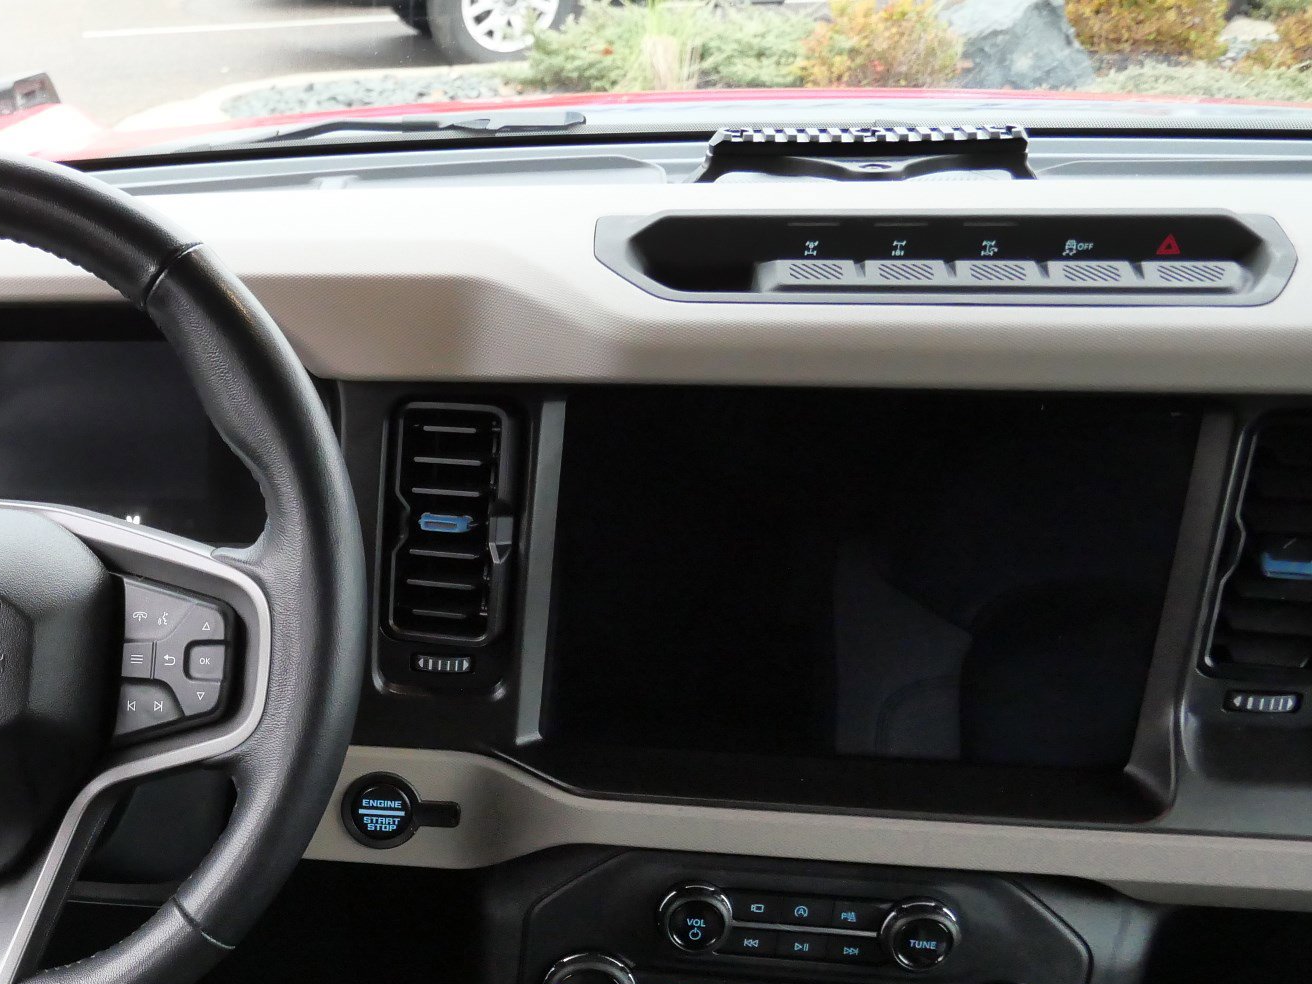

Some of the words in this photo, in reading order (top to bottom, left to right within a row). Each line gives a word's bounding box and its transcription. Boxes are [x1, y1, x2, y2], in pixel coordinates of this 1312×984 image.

[1077, 242, 1094, 251] OFF
[199, 657, 211, 665] OK
[362, 799, 402, 809] ENGINE
[363, 816, 401, 825] START
[367, 823, 397, 832] STOP
[686, 918, 706, 928] VOL
[909, 939, 937, 950] TUNE
